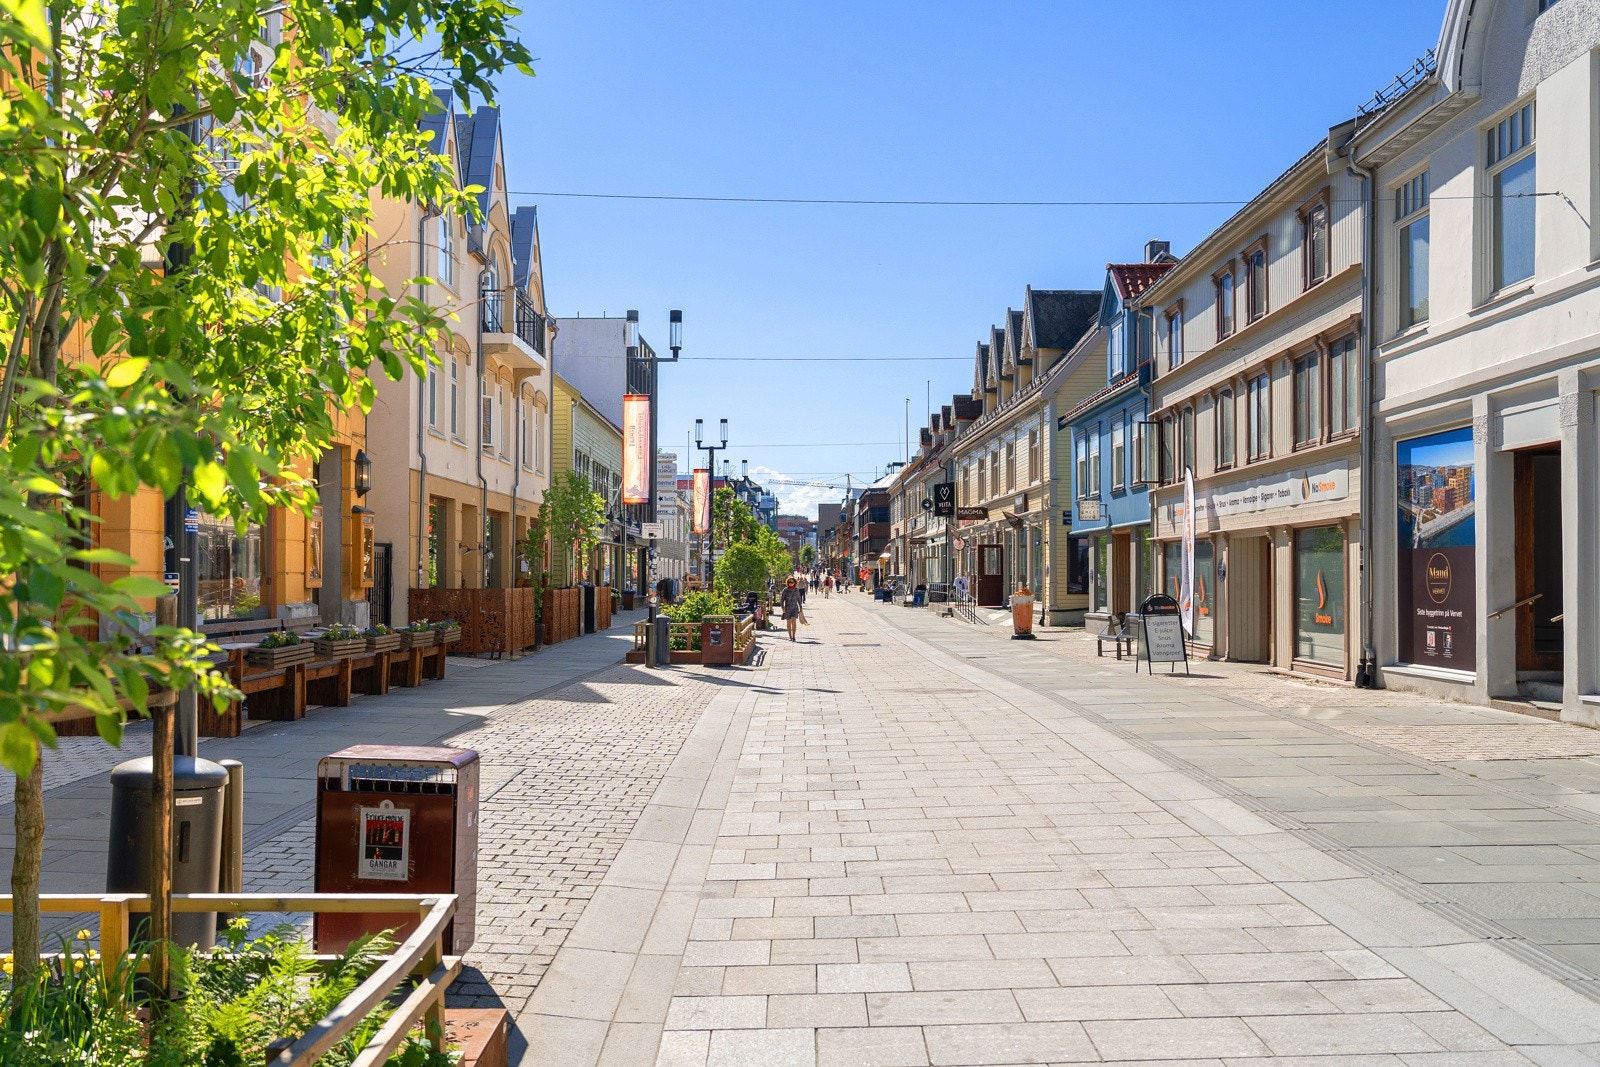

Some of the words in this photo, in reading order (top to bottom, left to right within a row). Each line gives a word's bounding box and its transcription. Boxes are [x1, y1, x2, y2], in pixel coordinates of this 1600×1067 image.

[1429, 566, 1448, 579] Maud
[1315, 613, 1332, 624] Smoke
[1426, 609, 1444, 618] byggetrinn
[370, 860, 398, 869] GANGAR
